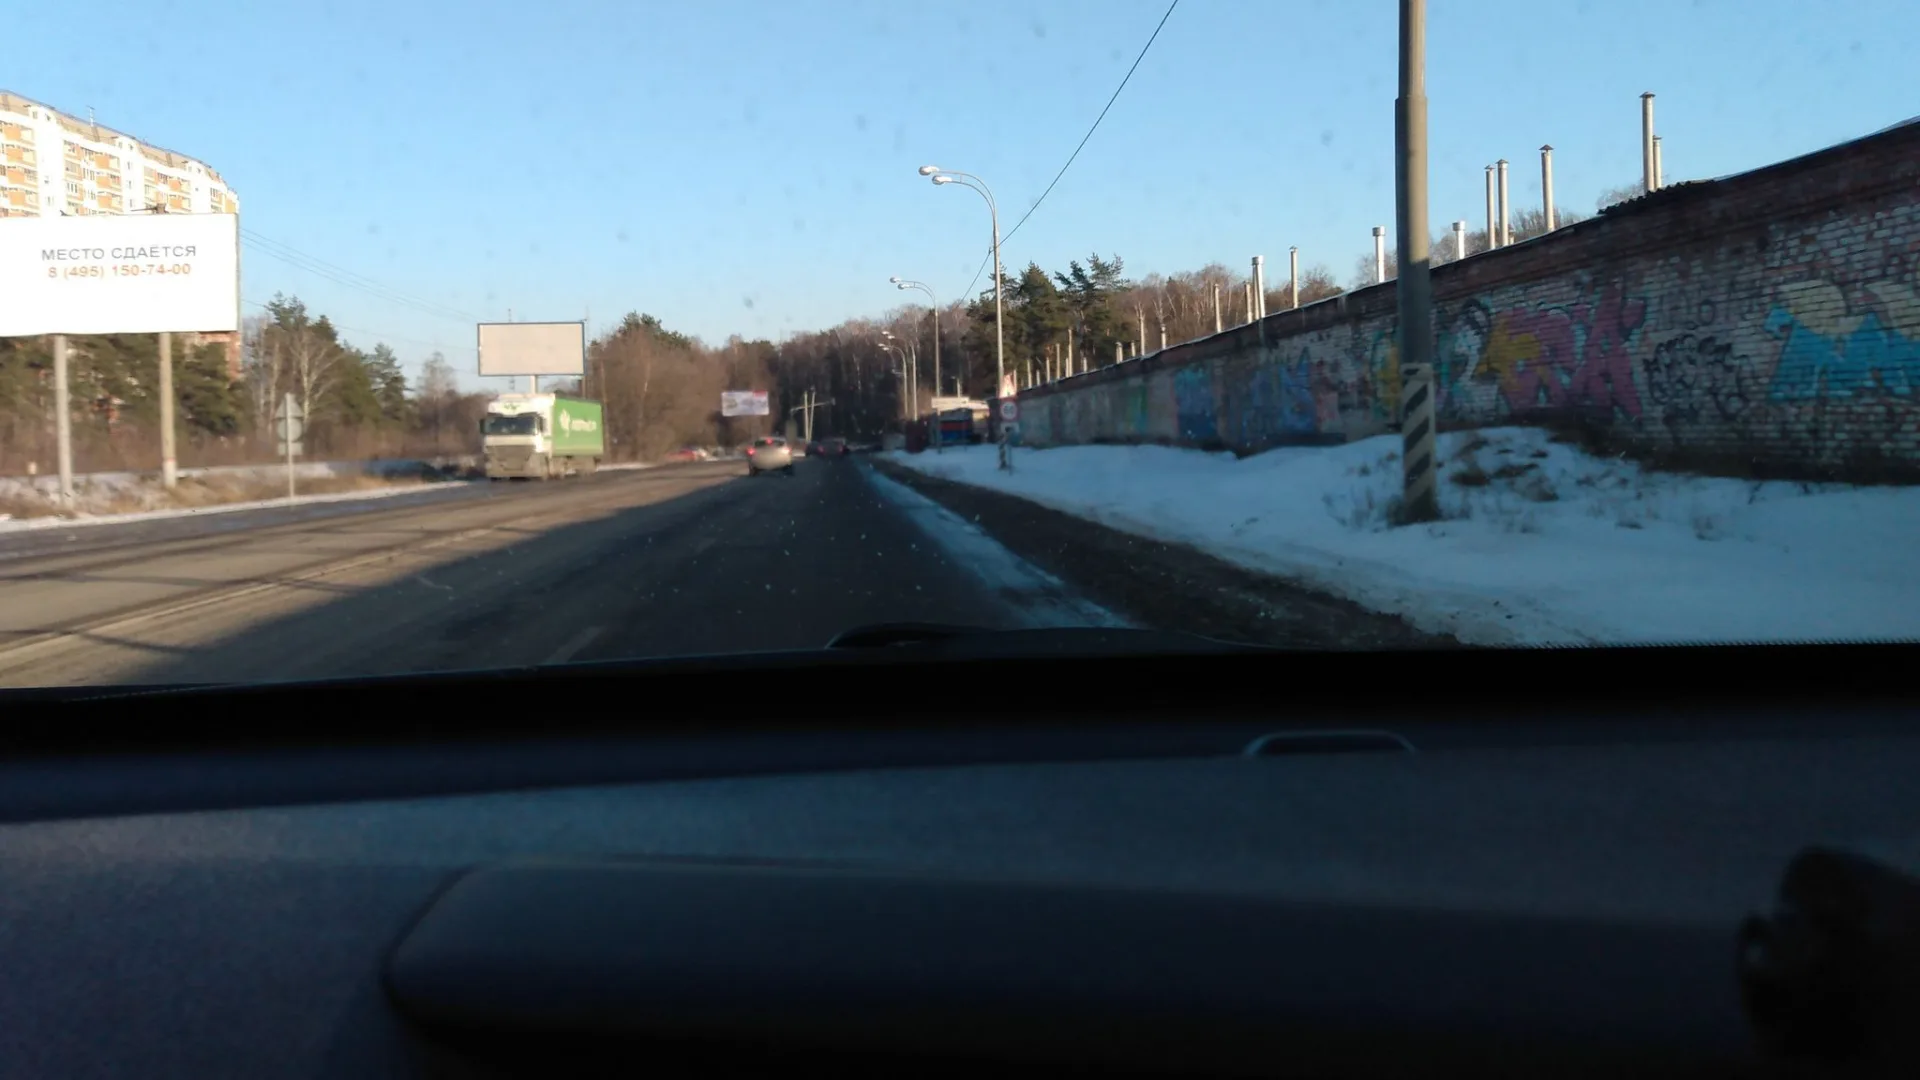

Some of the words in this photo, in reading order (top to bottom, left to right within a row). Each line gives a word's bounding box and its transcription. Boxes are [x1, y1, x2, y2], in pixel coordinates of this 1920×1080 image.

[41, 248, 105, 261] МЕСТО
[48, 266, 58, 279] 8
[63, 265, 105, 280] (495)
[112, 263, 192, 276] 150-74-00
